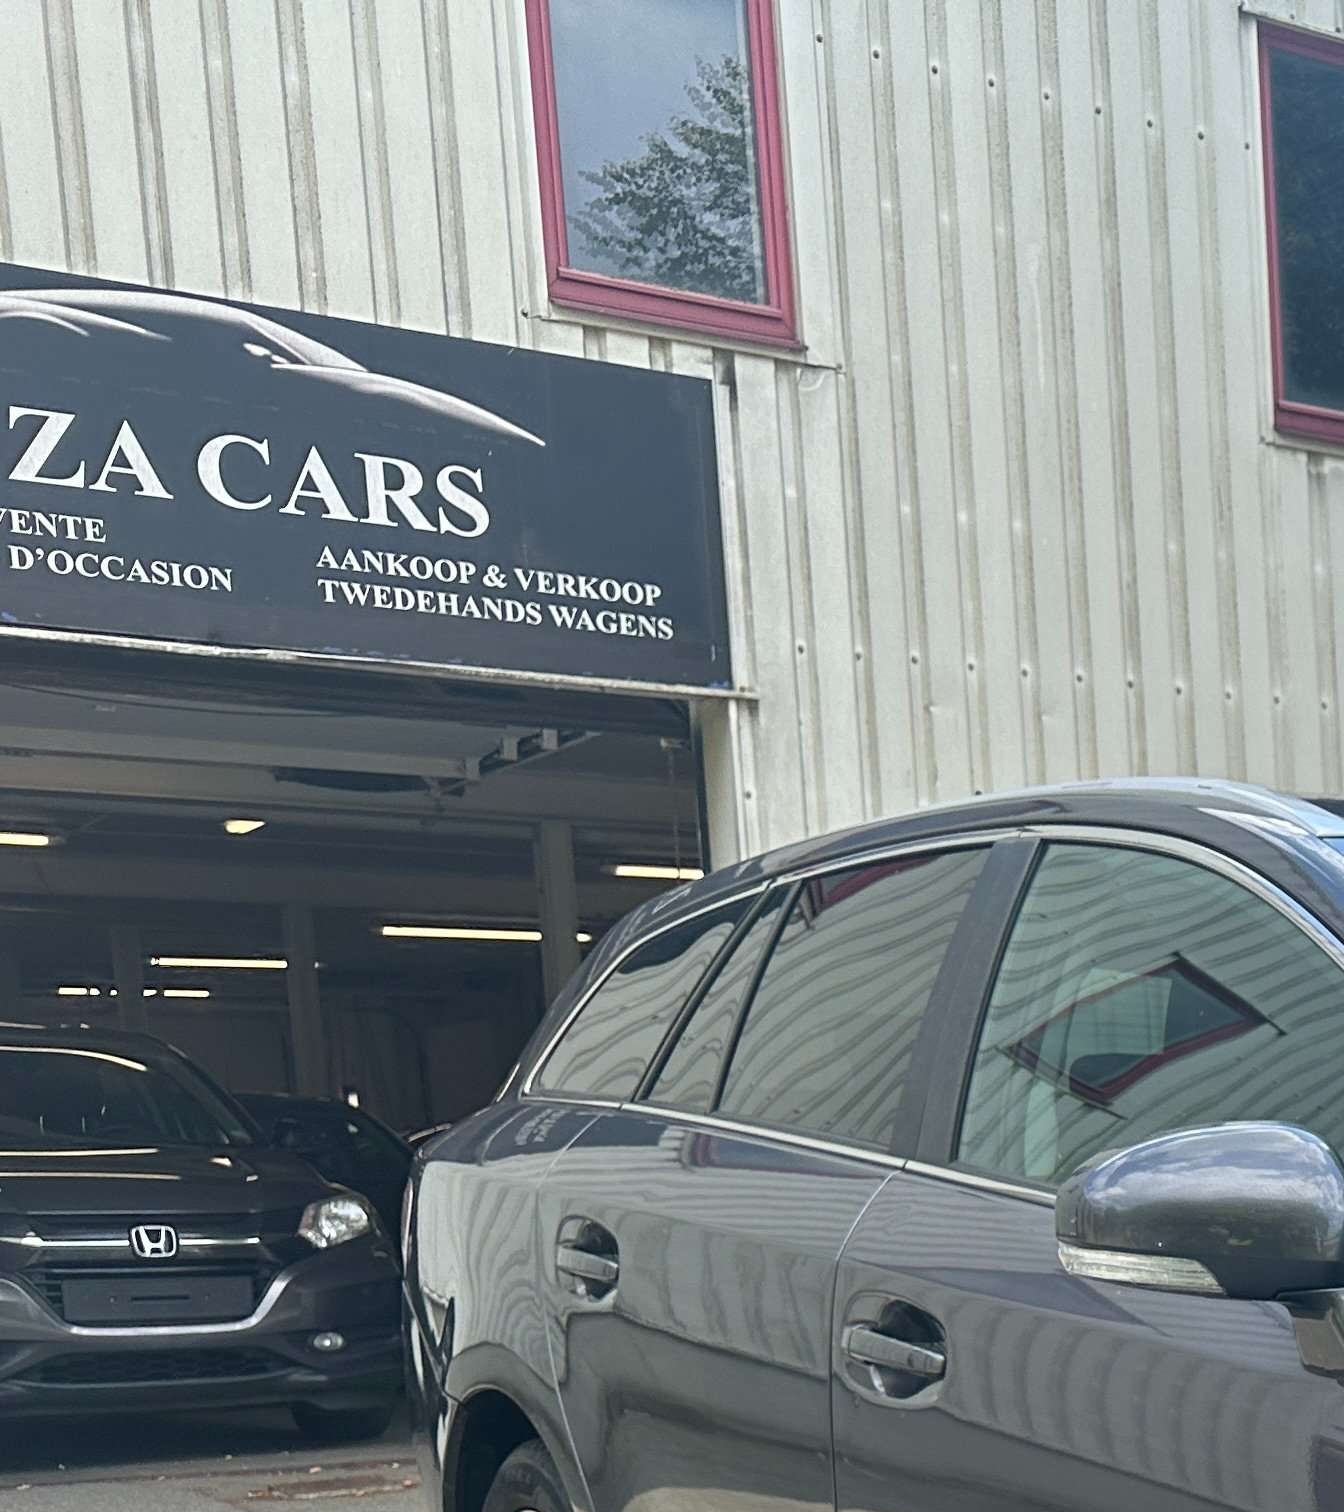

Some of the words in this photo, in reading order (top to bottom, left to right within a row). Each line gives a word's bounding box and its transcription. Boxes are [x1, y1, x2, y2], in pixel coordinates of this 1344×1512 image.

[8, 405, 174, 500] ZA
[197, 434, 490, 538] CARS
[316, 545, 476, 584] AANKOOP
[482, 564, 508, 589] &
[513, 568, 662, 606] VERKOOP
[317, 578, 543, 626] TWEDEHANDS
[548, 604, 674, 640] WAGENS
